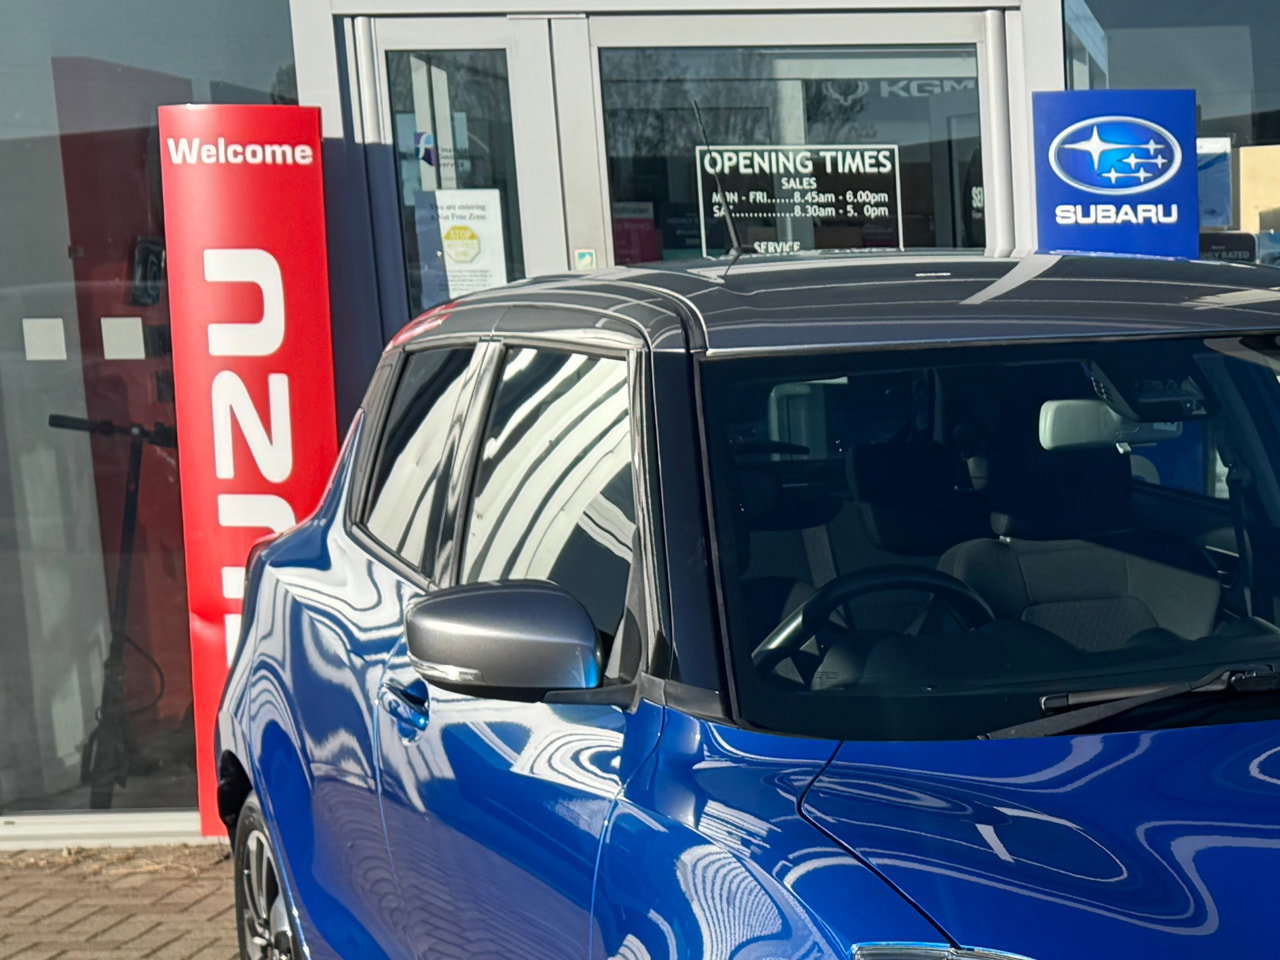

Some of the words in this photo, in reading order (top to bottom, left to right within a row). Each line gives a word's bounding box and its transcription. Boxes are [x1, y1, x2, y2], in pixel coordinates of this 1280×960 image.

[879, 79, 976, 98] KGM
[167, 137, 314, 165] Welcome
[703, 151, 814, 175] OPENING
[820, 150, 893, 174] TIMES
[781, 177, 817, 190] SALES
[846, 191, 888, 206] 6.00pm
[1055, 203, 1178, 225] SUBARU
[753, 241, 801, 254] SERVICE
